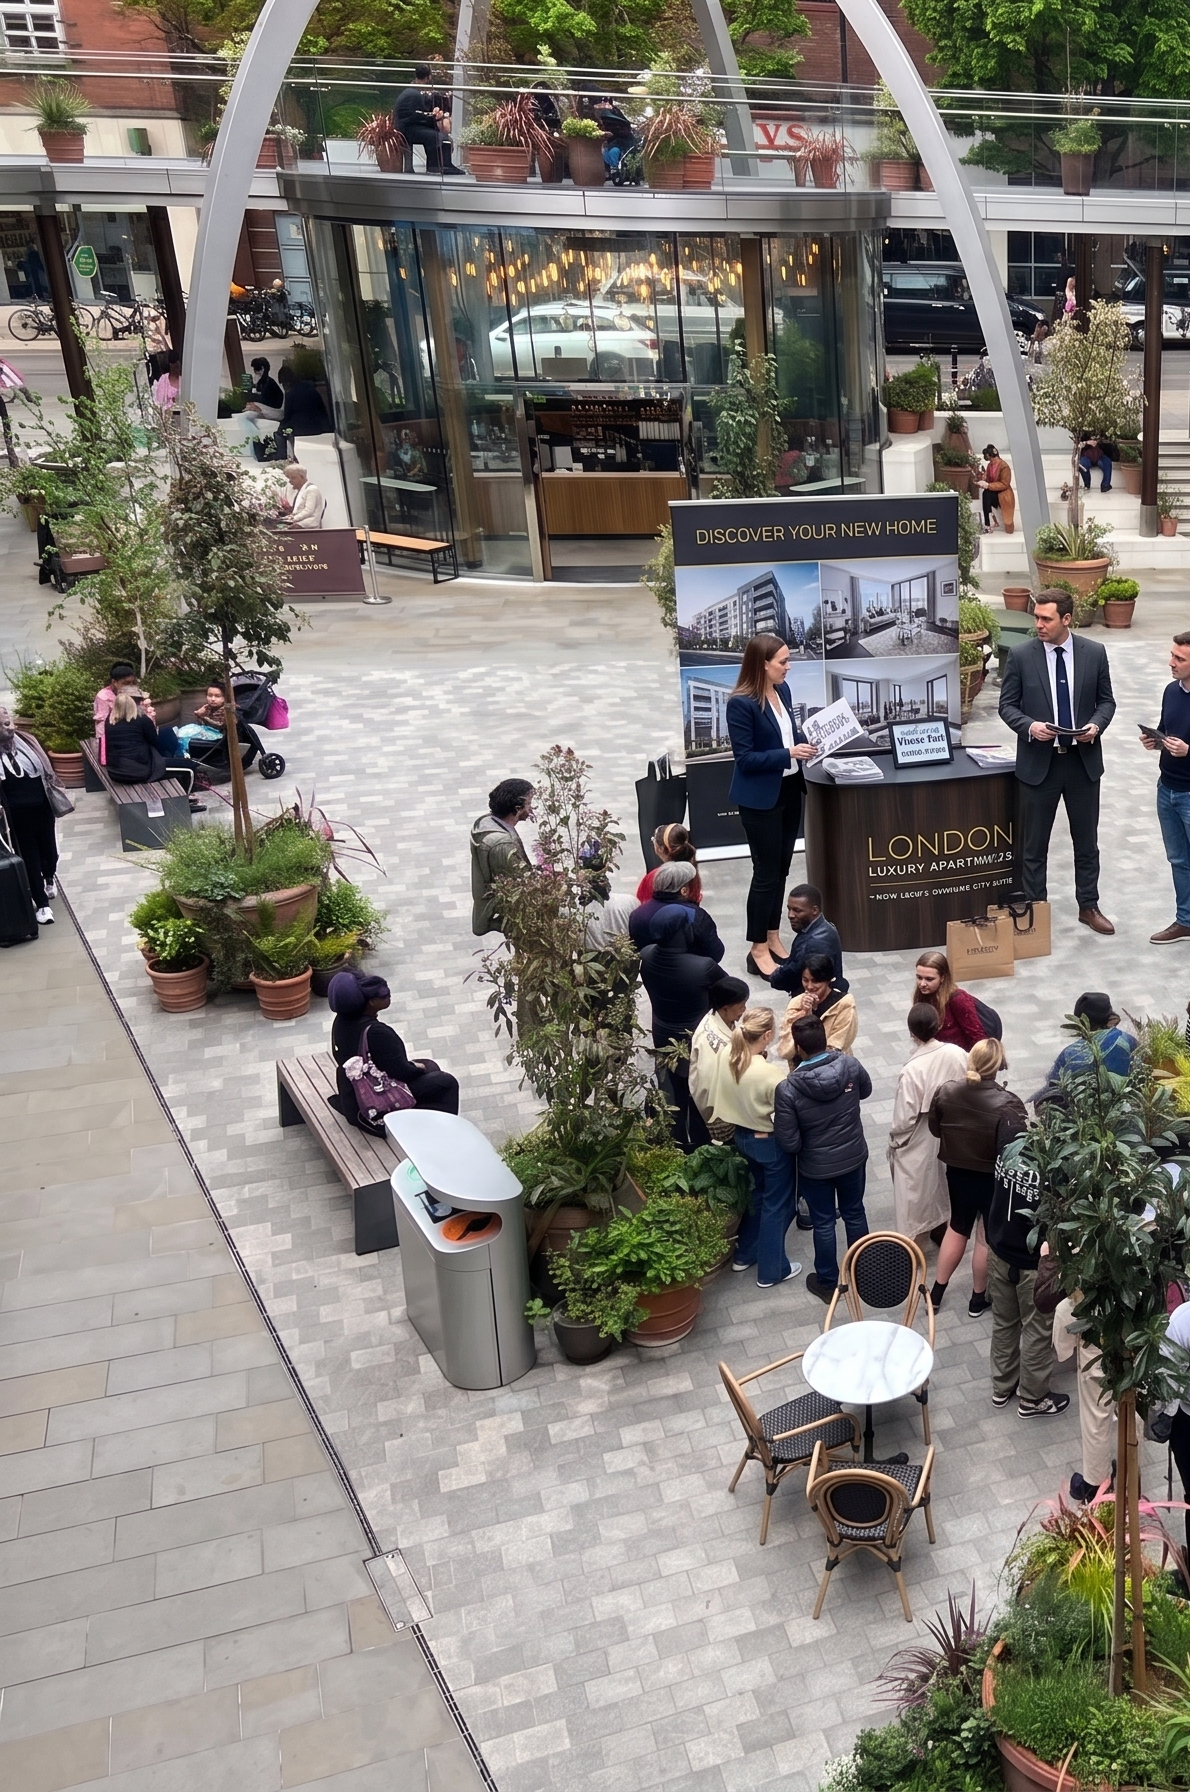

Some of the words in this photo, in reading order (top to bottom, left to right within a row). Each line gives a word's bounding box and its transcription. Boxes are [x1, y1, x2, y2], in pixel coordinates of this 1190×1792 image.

[695, 526, 785, 545] DISCOVER
[788, 523, 837, 540] YOUR
[841, 521, 882, 538] NEW
[885, 518, 937, 536] HOME
[868, 821, 1013, 861] LONDON
[868, 863, 925, 877] LUXURY
[876, 892, 898, 900] NOW
